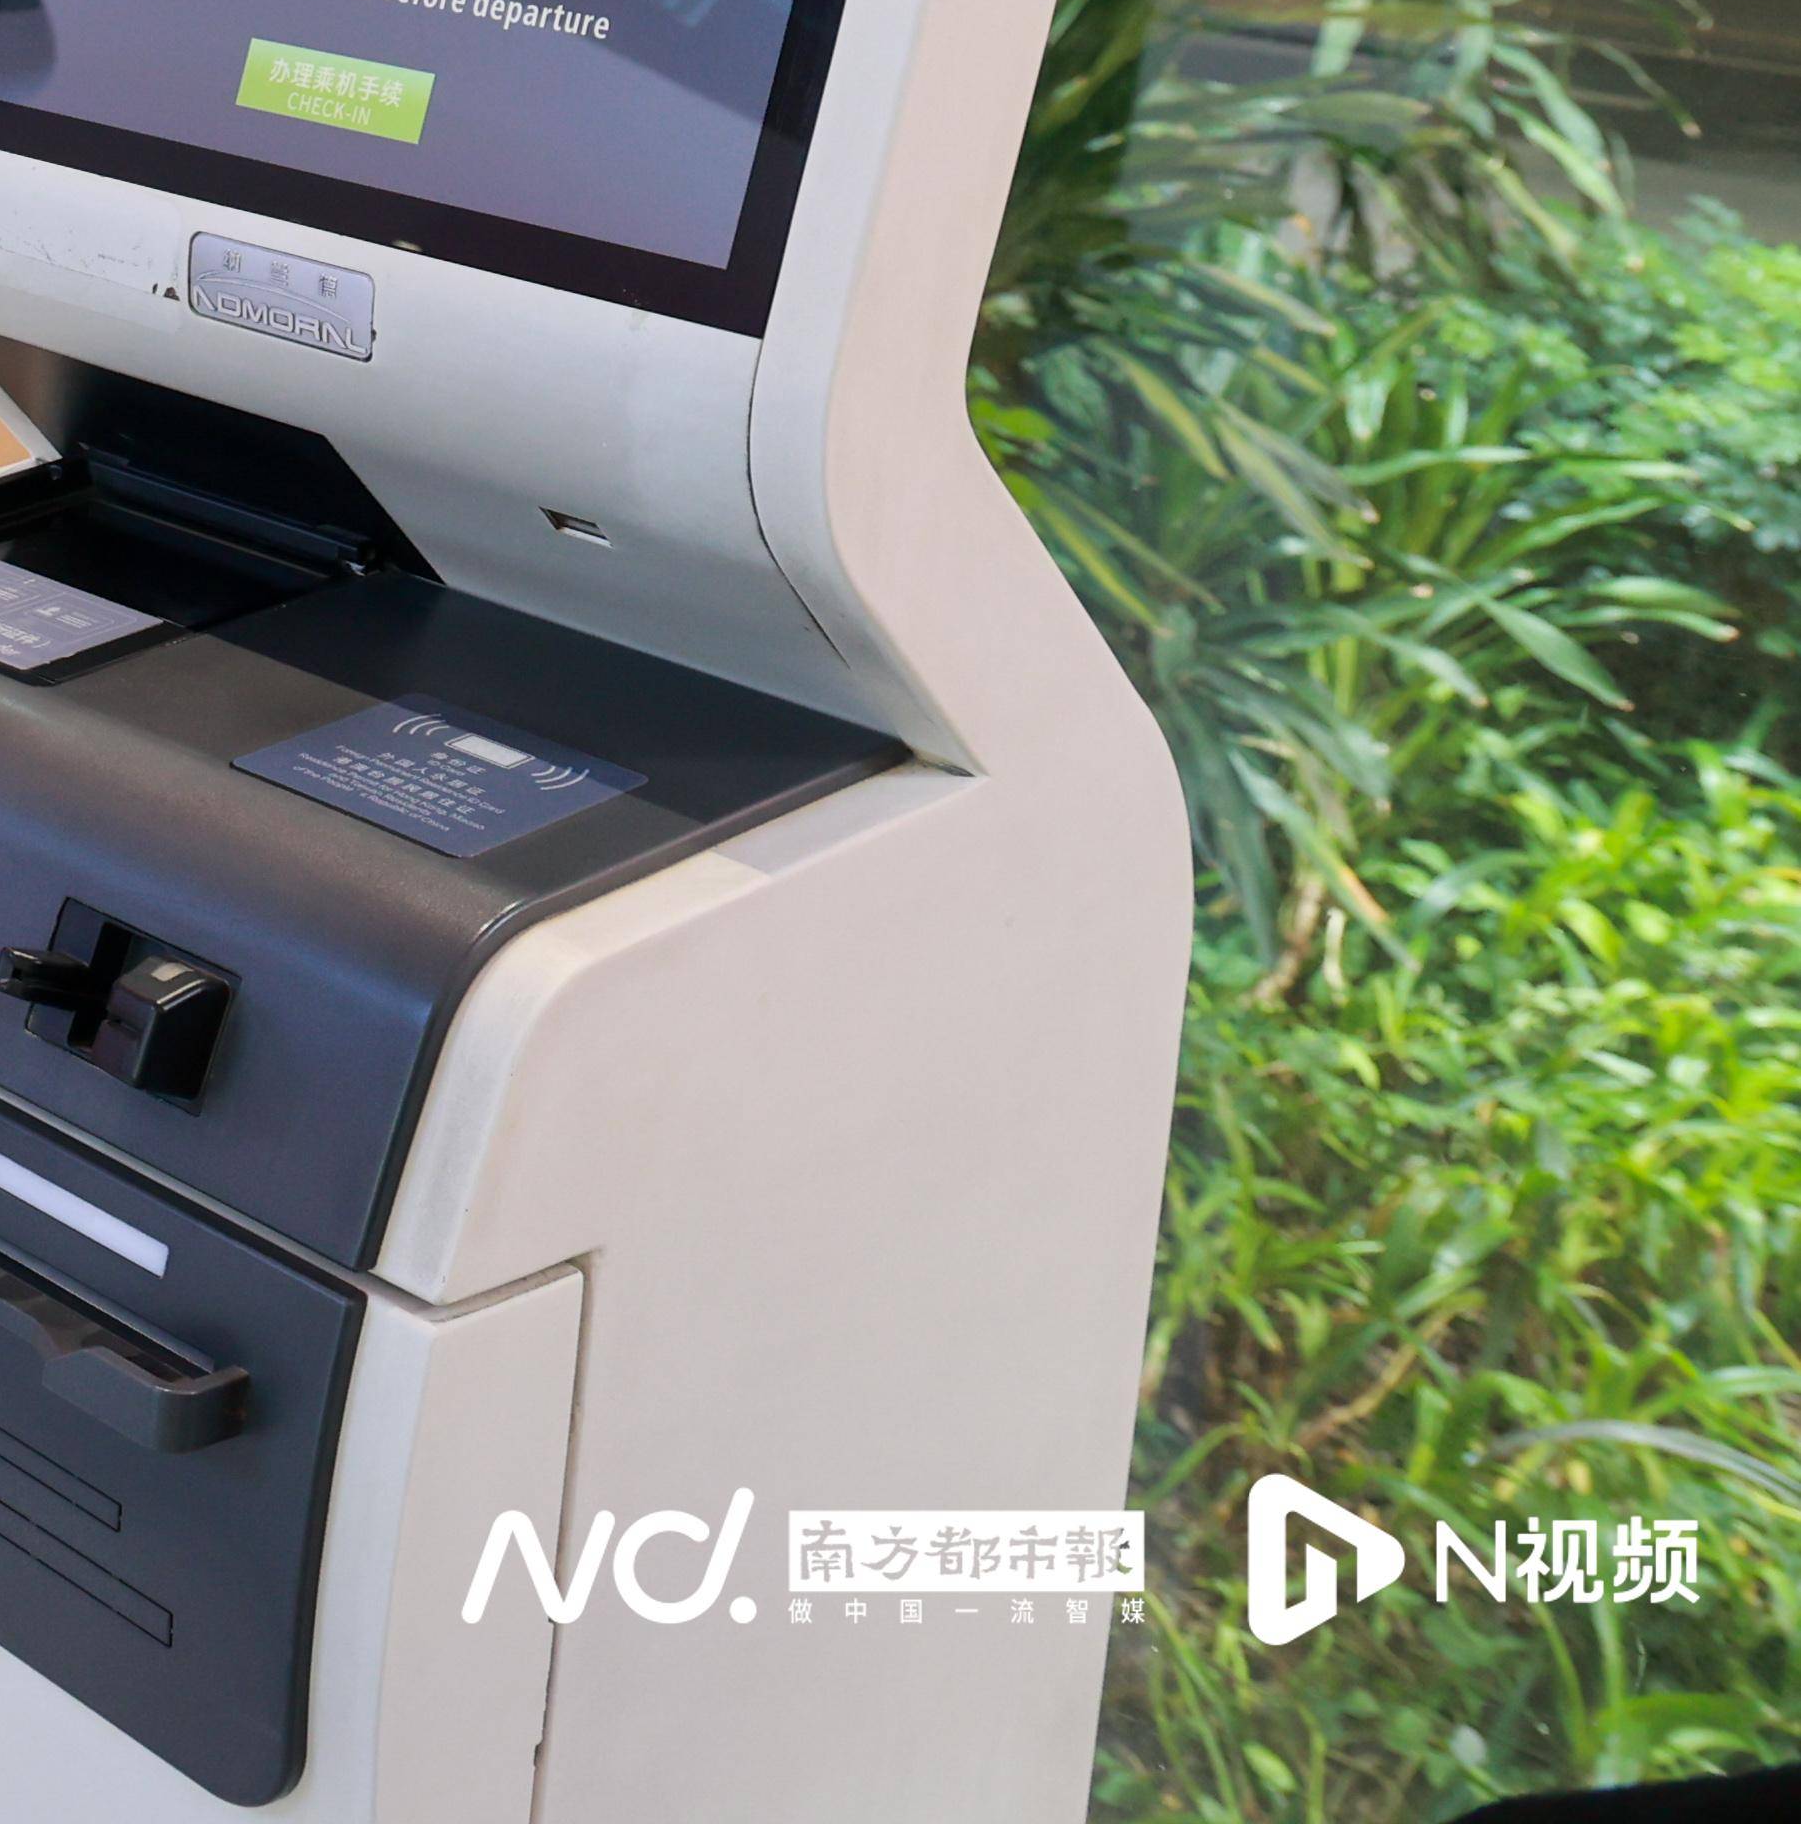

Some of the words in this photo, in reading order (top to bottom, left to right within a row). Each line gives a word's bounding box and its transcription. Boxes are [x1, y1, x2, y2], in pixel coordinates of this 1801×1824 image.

[269, 57, 405, 108] 办理乘机手续
[286, 91, 372, 126] CHECK-IN
